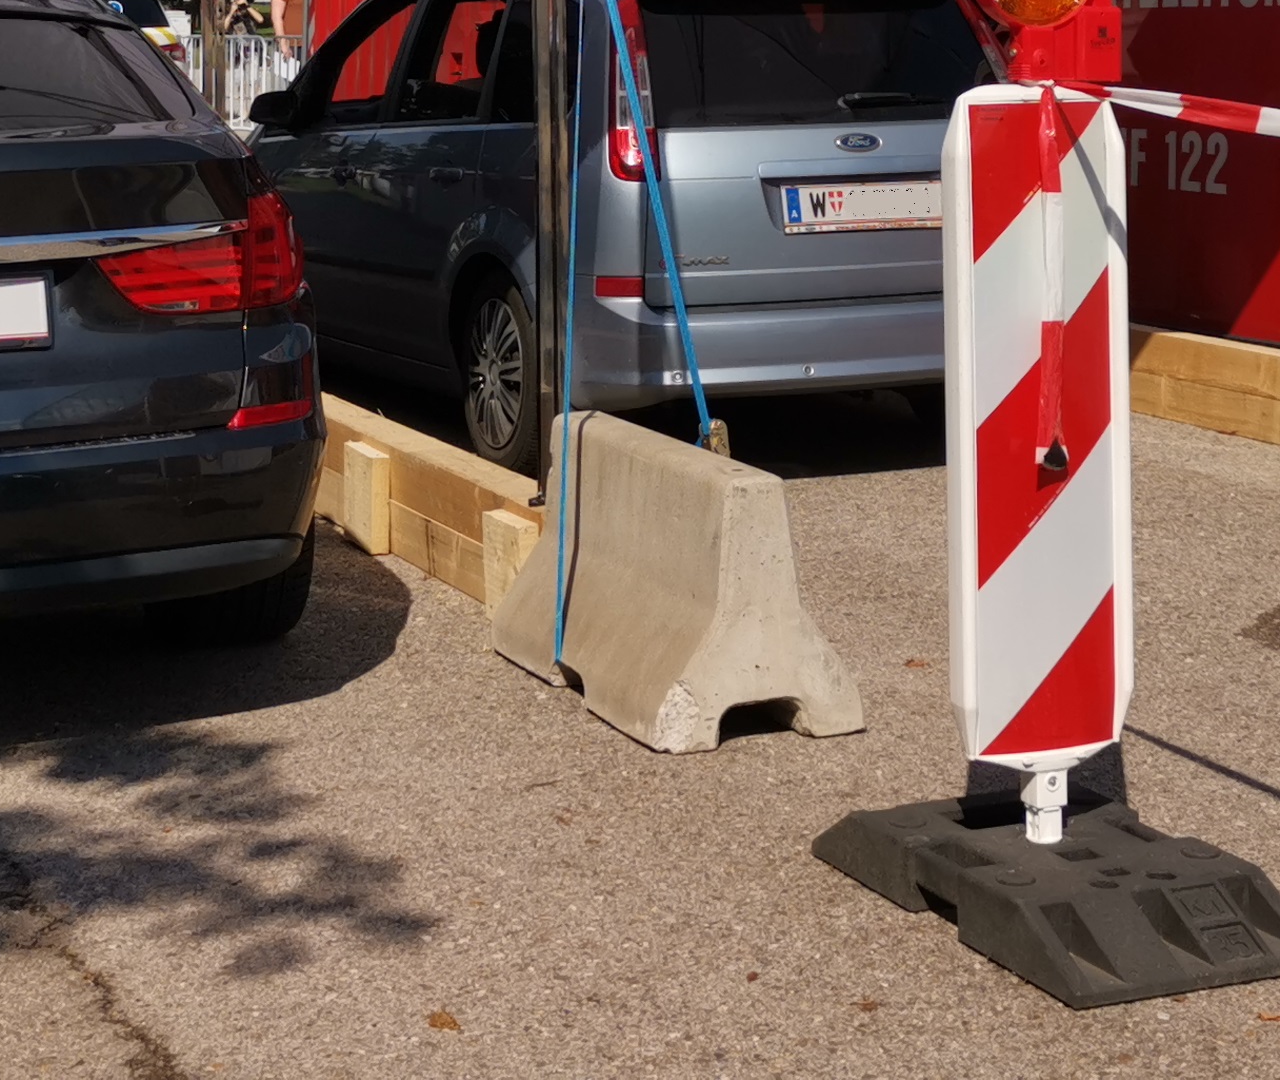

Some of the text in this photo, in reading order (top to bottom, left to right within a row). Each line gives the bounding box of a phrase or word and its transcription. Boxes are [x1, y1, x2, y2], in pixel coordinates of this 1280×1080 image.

[847, 135, 871, 147] Ford
[1165, 130, 1229, 195] 122
[791, 209, 799, 218] A
[809, 191, 826, 218] W
